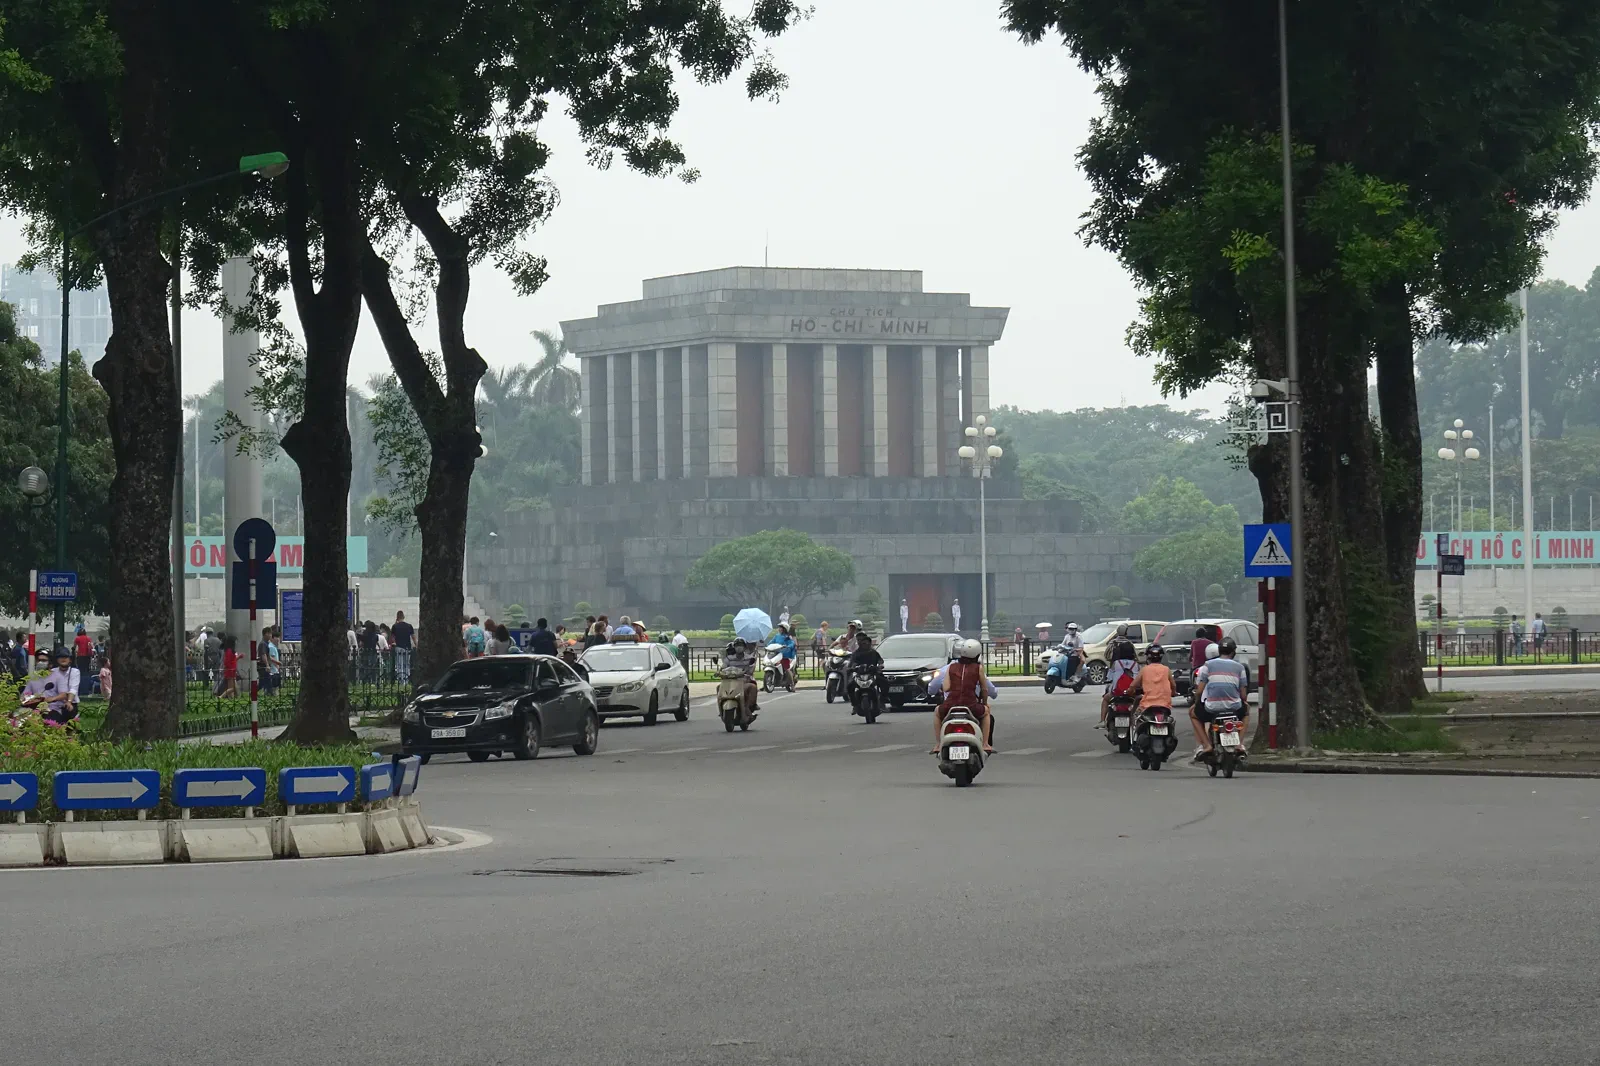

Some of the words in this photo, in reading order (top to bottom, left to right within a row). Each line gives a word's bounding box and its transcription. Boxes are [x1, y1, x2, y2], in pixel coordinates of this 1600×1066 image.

[1481, 533, 1504, 559] HỒ
[1511, 534, 1540, 559] CÍ
[1548, 538, 1594, 559] MINH
